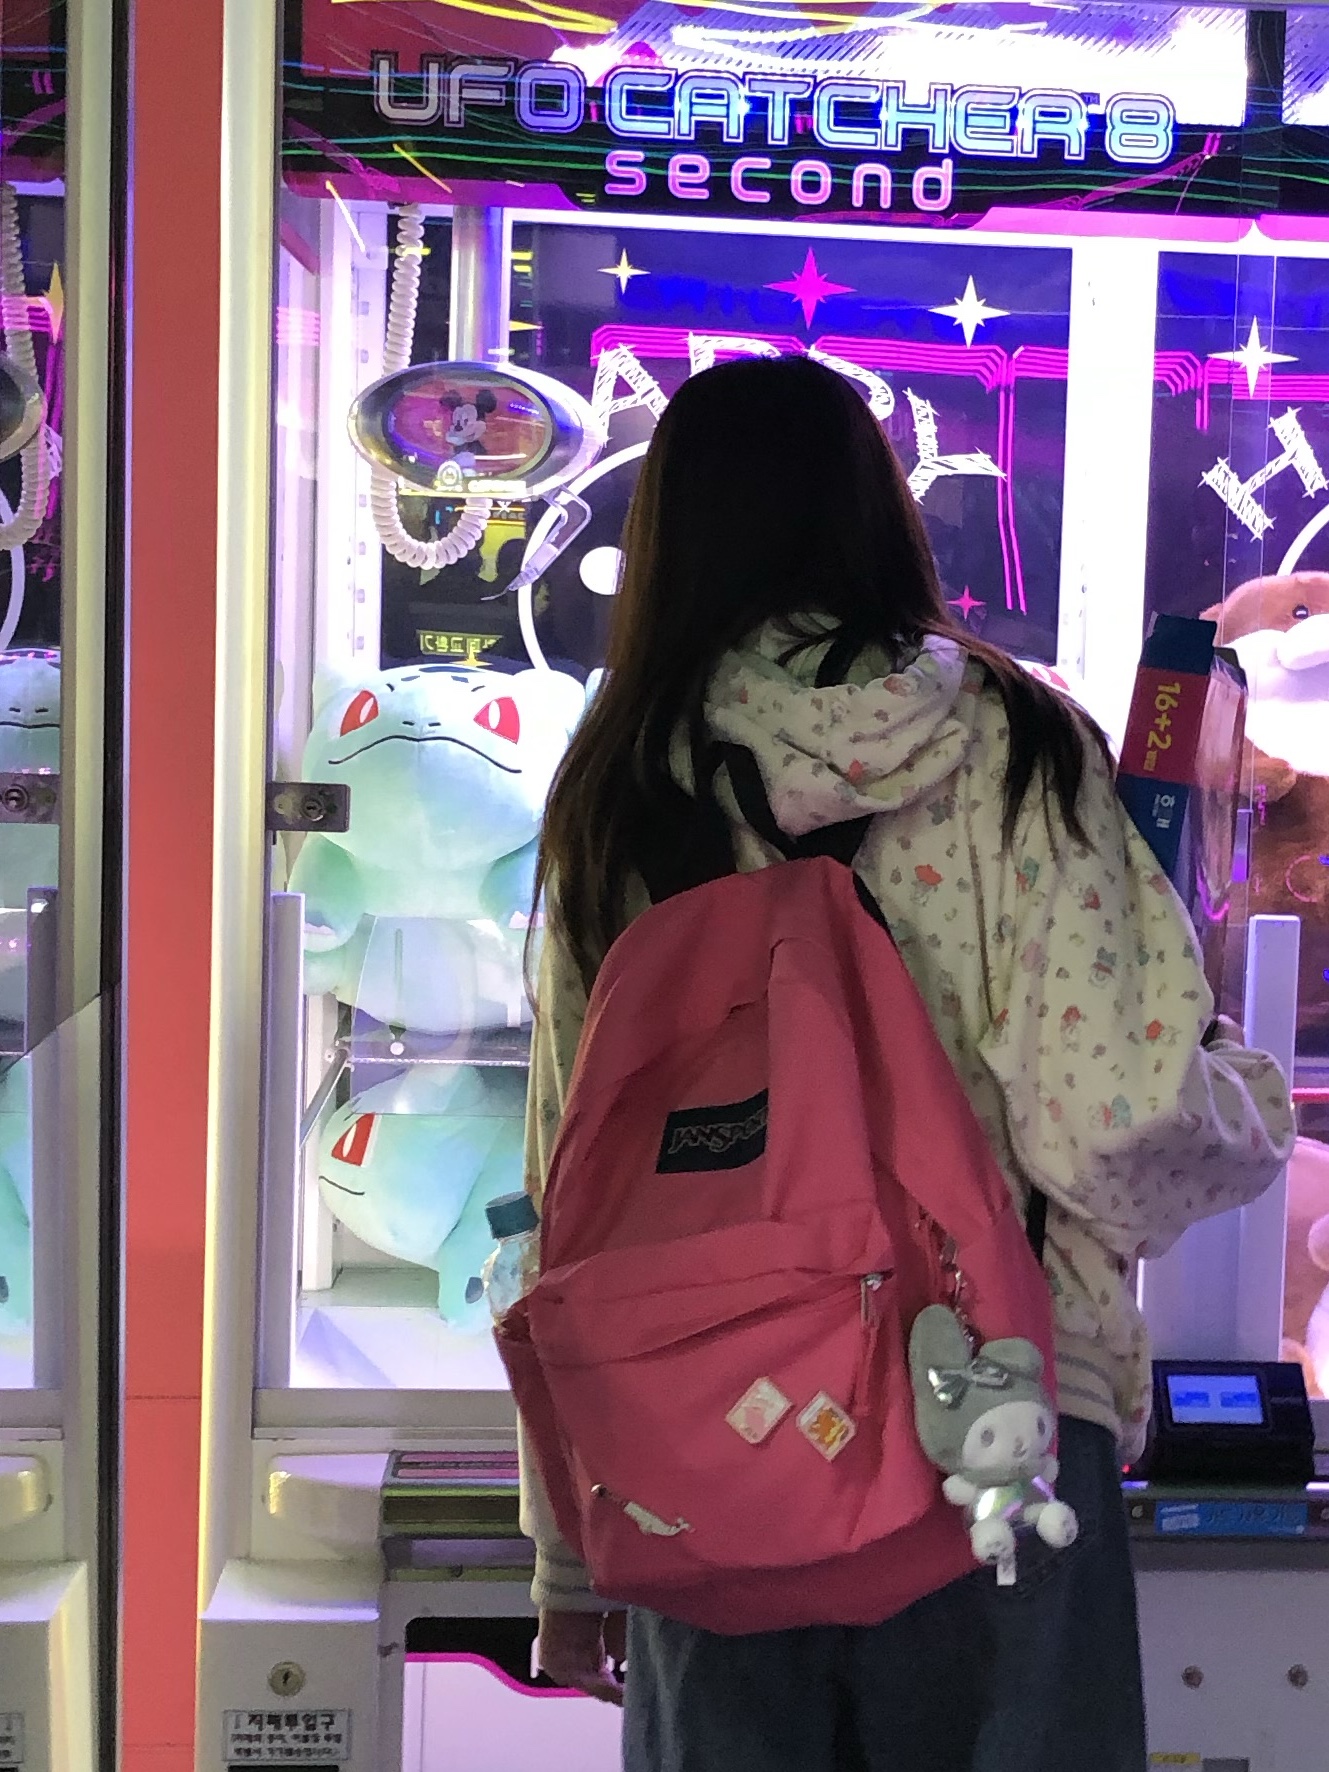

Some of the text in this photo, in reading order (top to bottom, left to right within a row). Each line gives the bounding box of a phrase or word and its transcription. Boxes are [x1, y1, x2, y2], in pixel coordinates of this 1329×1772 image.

[372, 52, 587, 133] UFO
[604, 66, 1086, 161] CATCHER
[1105, 92, 1176, 164] 8
[604, 150, 954, 212] second
